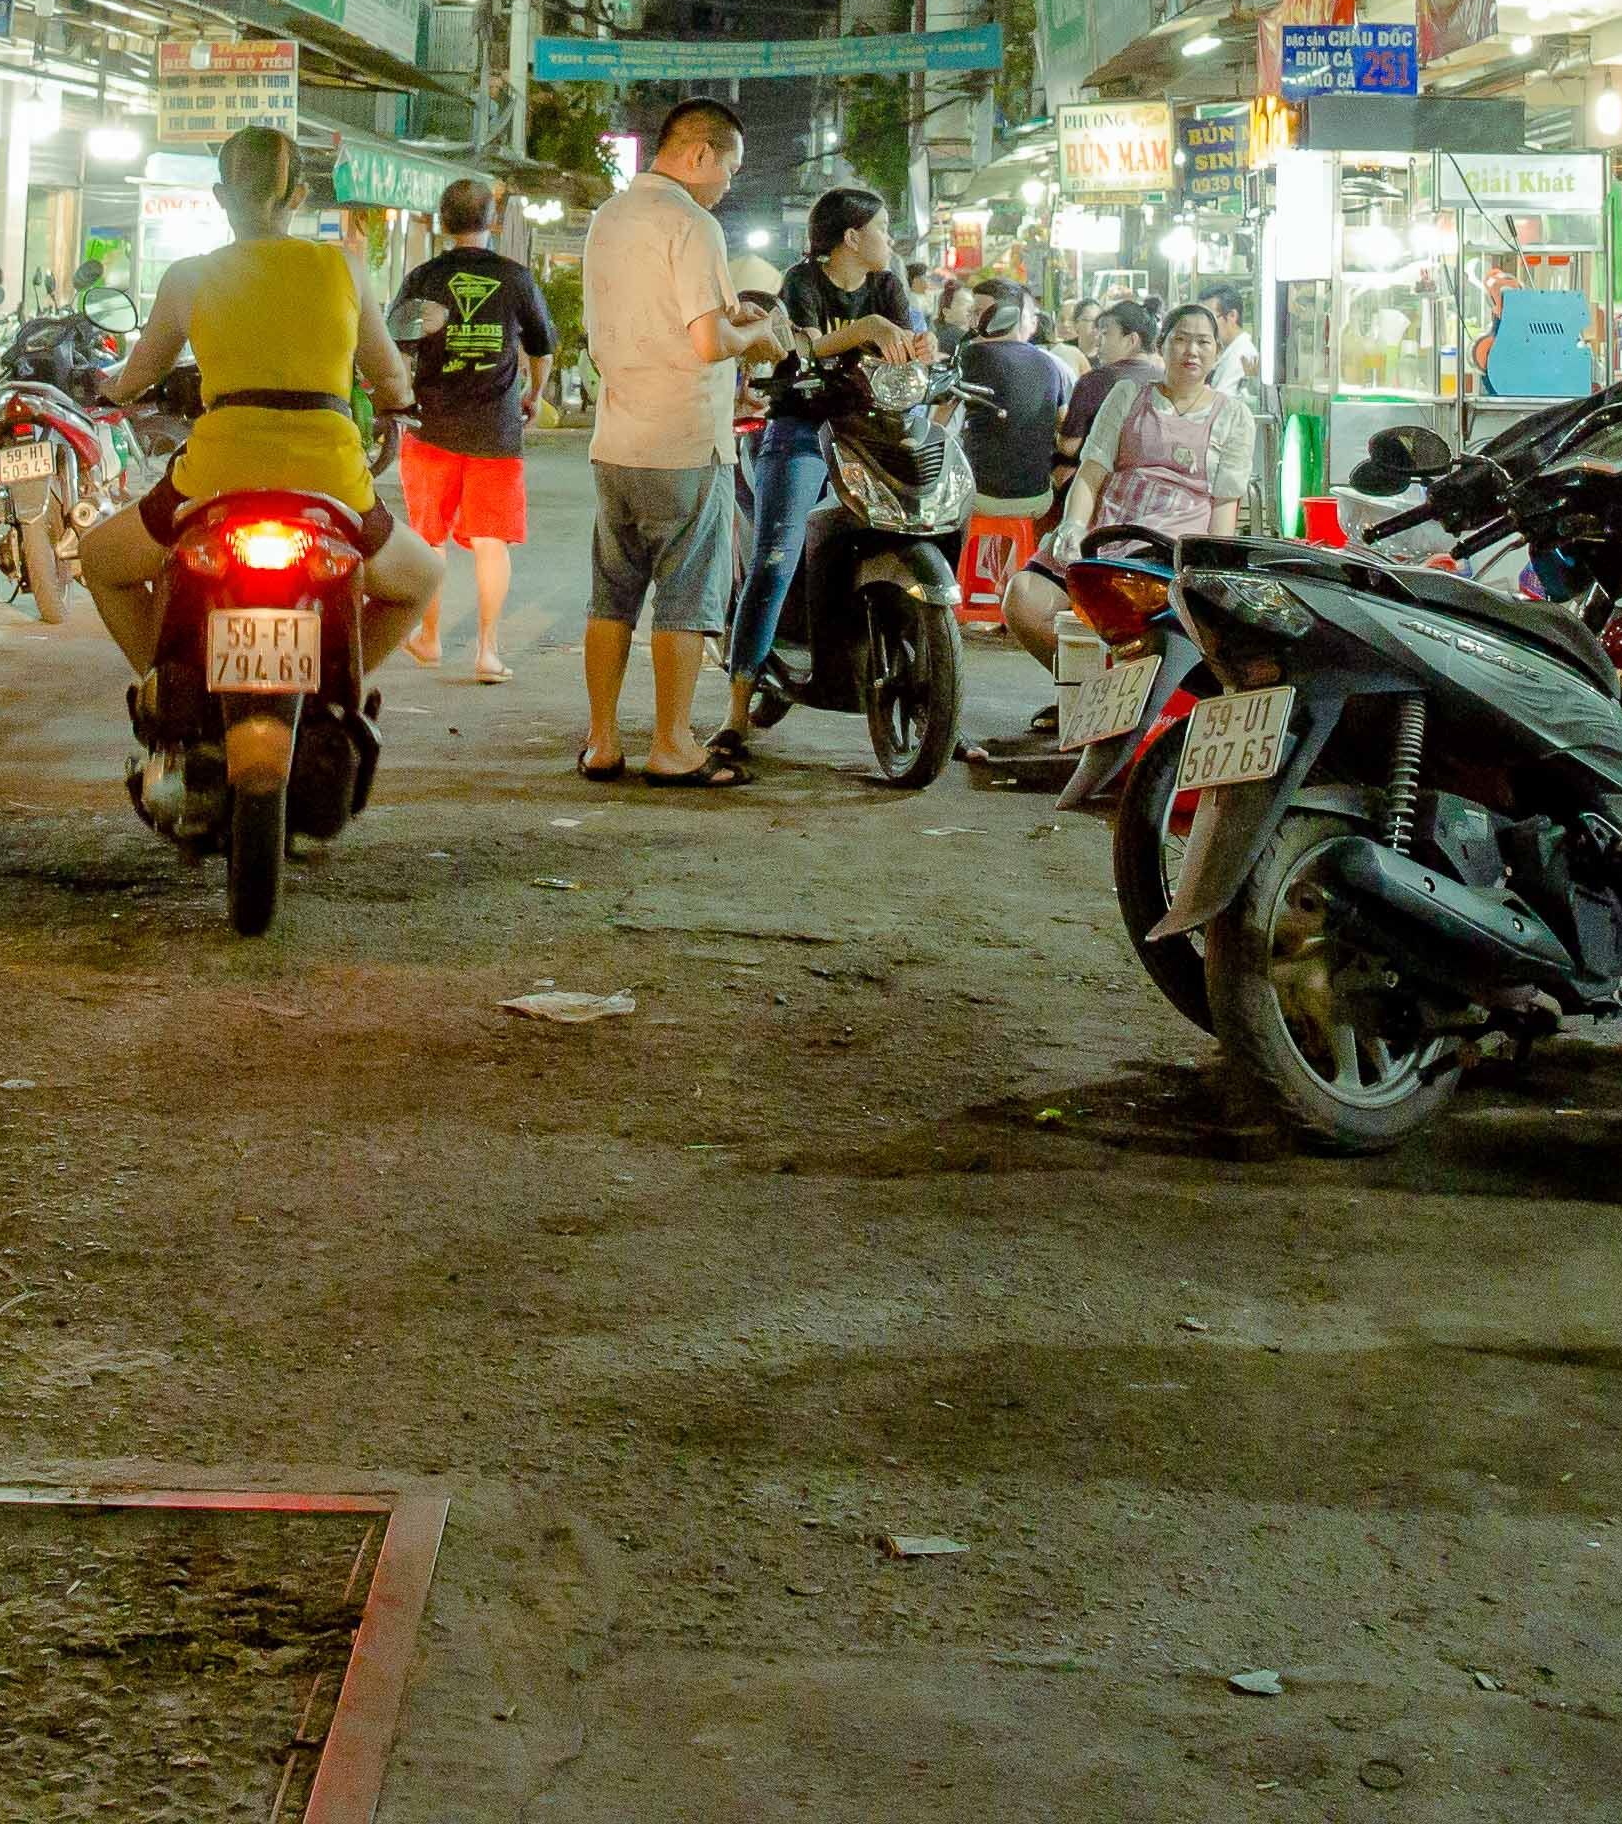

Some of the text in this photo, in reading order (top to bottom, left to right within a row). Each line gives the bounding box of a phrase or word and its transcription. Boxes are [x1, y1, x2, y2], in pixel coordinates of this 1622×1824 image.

[1329, 28, 1373, 46] CHÂU
[1379, 26, 1412, 46] ĐỐC
[1295, 47, 1353, 67] BÚN CÁ
[1337, 70, 1355, 88] CÁ
[1188, 121, 1234, 145] BÚN
[7, 445, 44, 464] 59-H1
[227, 617, 298, 650] 59-F1
[1204, 694, 1274, 740] 59-U1
